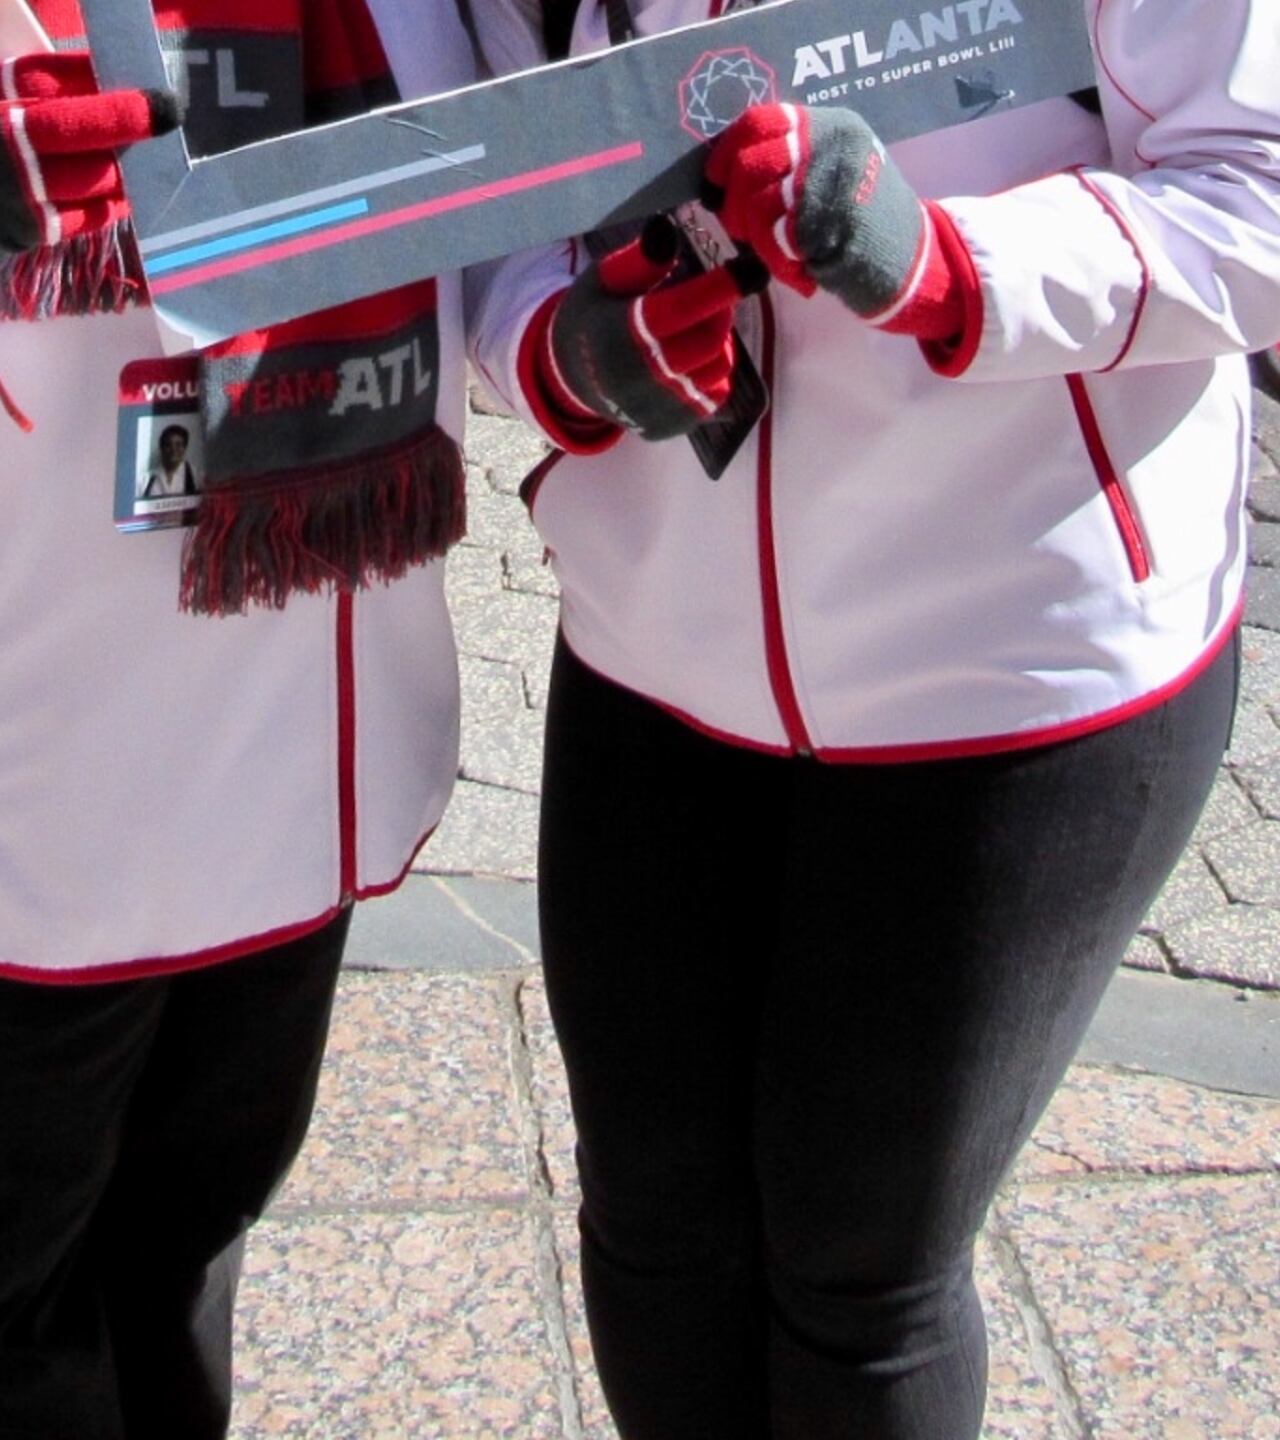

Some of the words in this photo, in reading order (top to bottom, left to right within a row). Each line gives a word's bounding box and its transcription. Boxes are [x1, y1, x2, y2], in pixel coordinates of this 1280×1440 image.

[159, 47, 270, 108] TL
[806, 82, 852, 106] HOST
[853, 74, 876, 92] TO
[881, 59, 934, 85] SUPER
[936, 47, 986, 69] BOWL
[988, 34, 1016, 55] LIII
[142, 380, 200, 401] VOLU
[223, 367, 338, 417] TEAM
[328, 336, 433, 417] ATL
